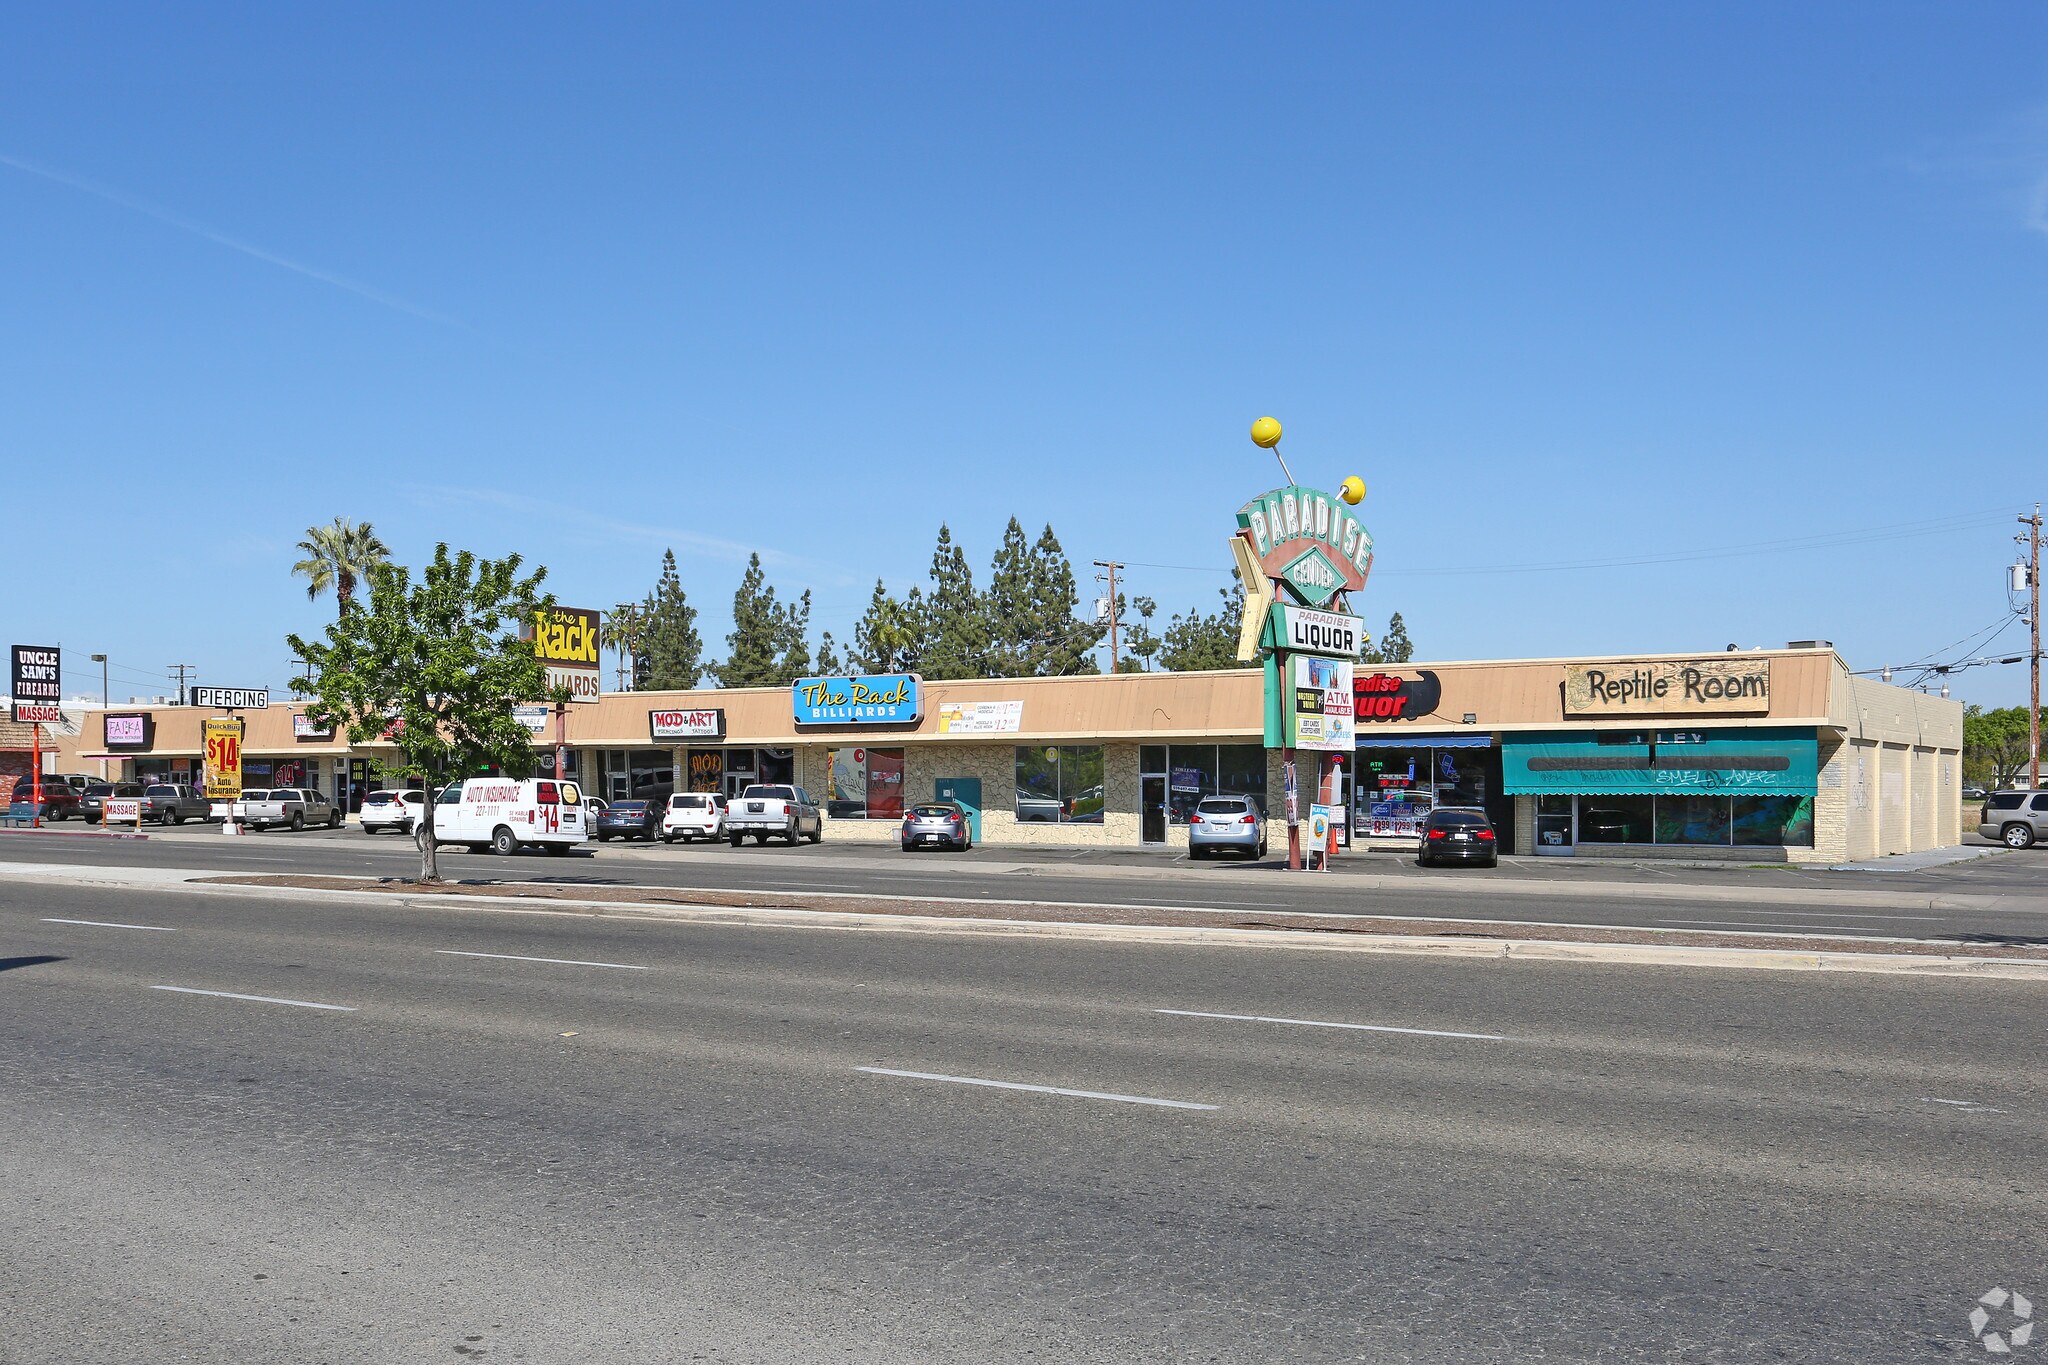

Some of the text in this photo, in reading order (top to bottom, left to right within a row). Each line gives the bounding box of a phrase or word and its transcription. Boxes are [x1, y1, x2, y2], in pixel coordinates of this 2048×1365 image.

[1251, 494, 1373, 572] PARADISE
[1294, 556, 1335, 590] CENTER
[553, 610, 576, 624] the
[1298, 611, 1350, 628] PARADISE
[535, 611, 597, 662] Rack
[1295, 622, 1353, 651] LIQUOR
[19, 651, 57, 665] UNCLE
[22, 665, 56, 680] SAM'S
[17, 682, 59, 696] FIREARMS
[801, 680, 909, 707] The Rack
[1587, 668, 1767, 704] Reptile Room
[200, 690, 265, 706] PIERCING
[1326, 692, 1350, 704] ATM
[1354, 696, 1408, 716] uor
[18, 706, 59, 721] MASSAGE
[812, 706, 896, 718] BILLIARDS
[1325, 706, 1352, 715] AVAILABLE
[654, 712, 716, 727] MOD & ART
[208, 737, 237, 772] $14
[208, 786, 240, 794] Insurance
[466, 786, 520, 802] AUTO INSURANCE
[107, 804, 136, 815] MASSAGE
[539, 805, 558, 833] $14
